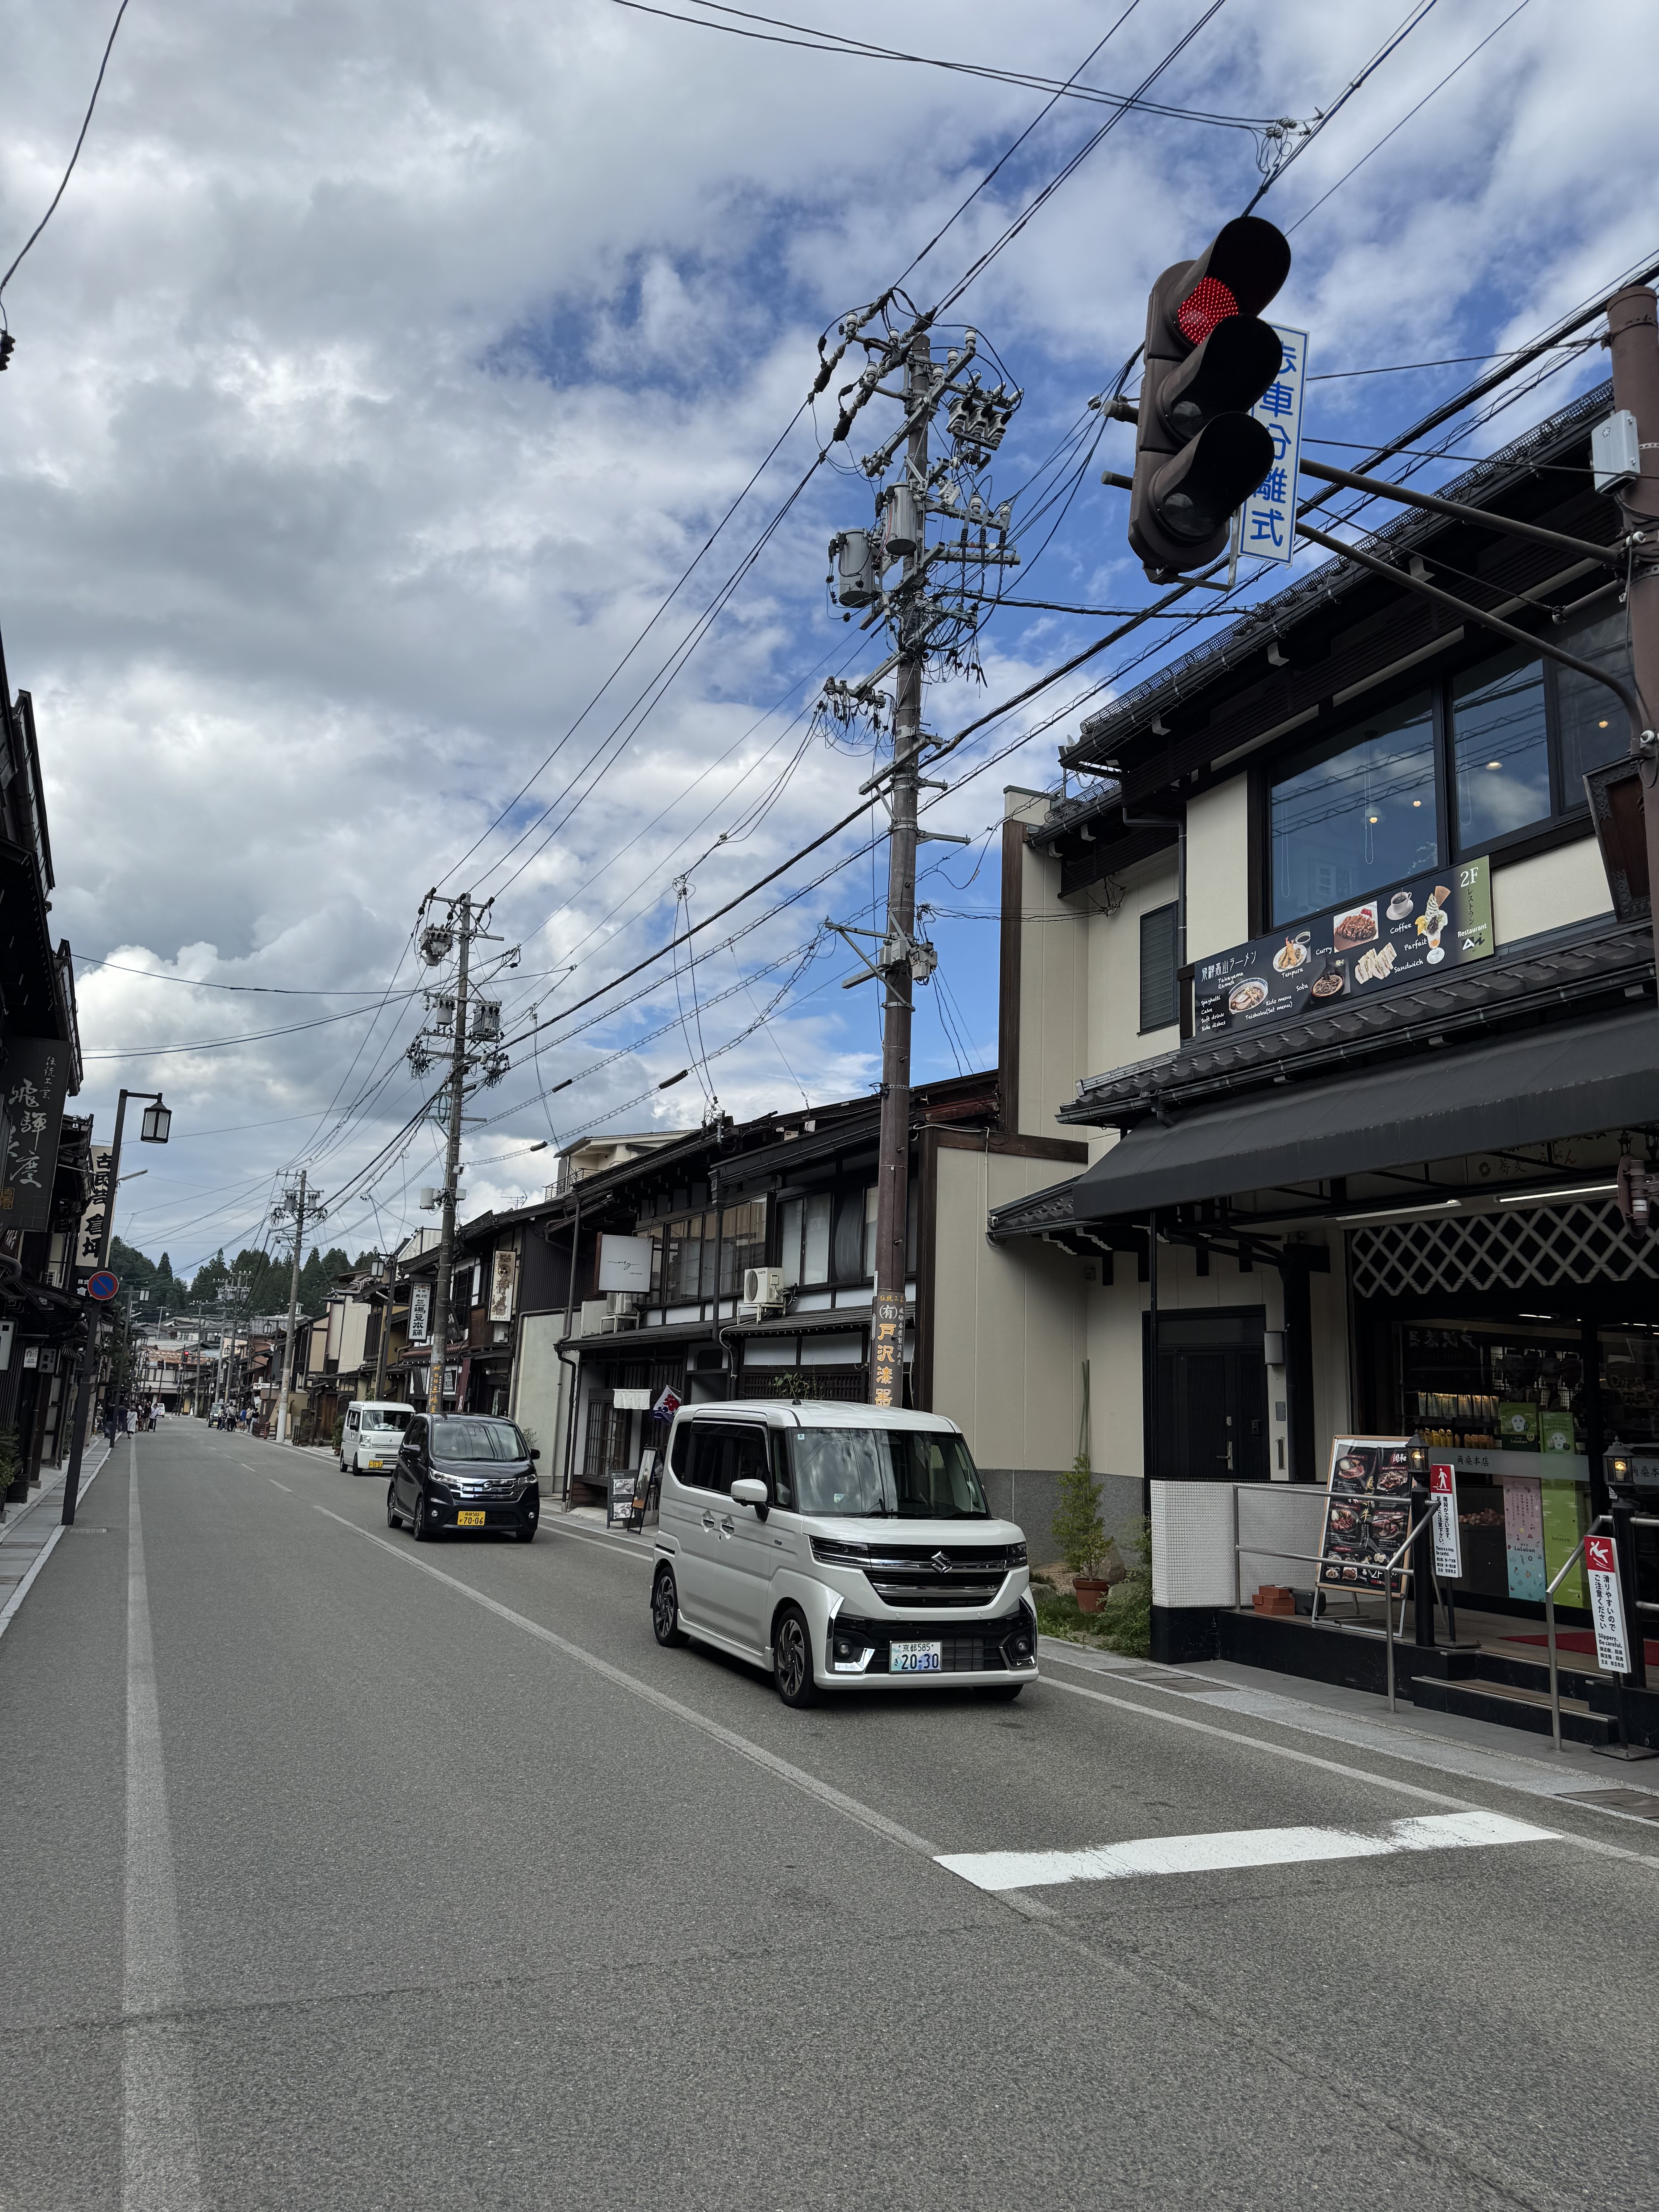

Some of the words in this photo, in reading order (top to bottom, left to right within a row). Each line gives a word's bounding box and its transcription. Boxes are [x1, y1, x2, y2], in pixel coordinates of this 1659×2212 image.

[1460, 867, 1479, 888] 2F
[1390, 922, 1412, 934] Coffee
[1458, 923, 1487, 938] Restaurant
[1316, 947, 1332, 955] Curry
[1404, 938, 1427, 951] Parfait
[1201, 951, 1256, 982] 飛騨高山ラーメン
[1394, 958, 1423, 973] Sandwich
[1218, 972, 1244, 984] Takayama
[1218, 981, 1235, 989] Ramen
[1296, 983, 1309, 991] Soba
[1201, 995, 1221, 1008] Spaghetti
[412, 1300, 426, 1336] 三嶋豆本舗
[1458, 1455, 1489, 1466] 角桑本店
[1595, 1574, 1607, 1629] ご注意ください
[1603, 1575, 1616, 1631] 滑りやすいので
[1598, 1633, 1618, 1642] Slippery.
[901, 1653, 939, 1670] 20-30
